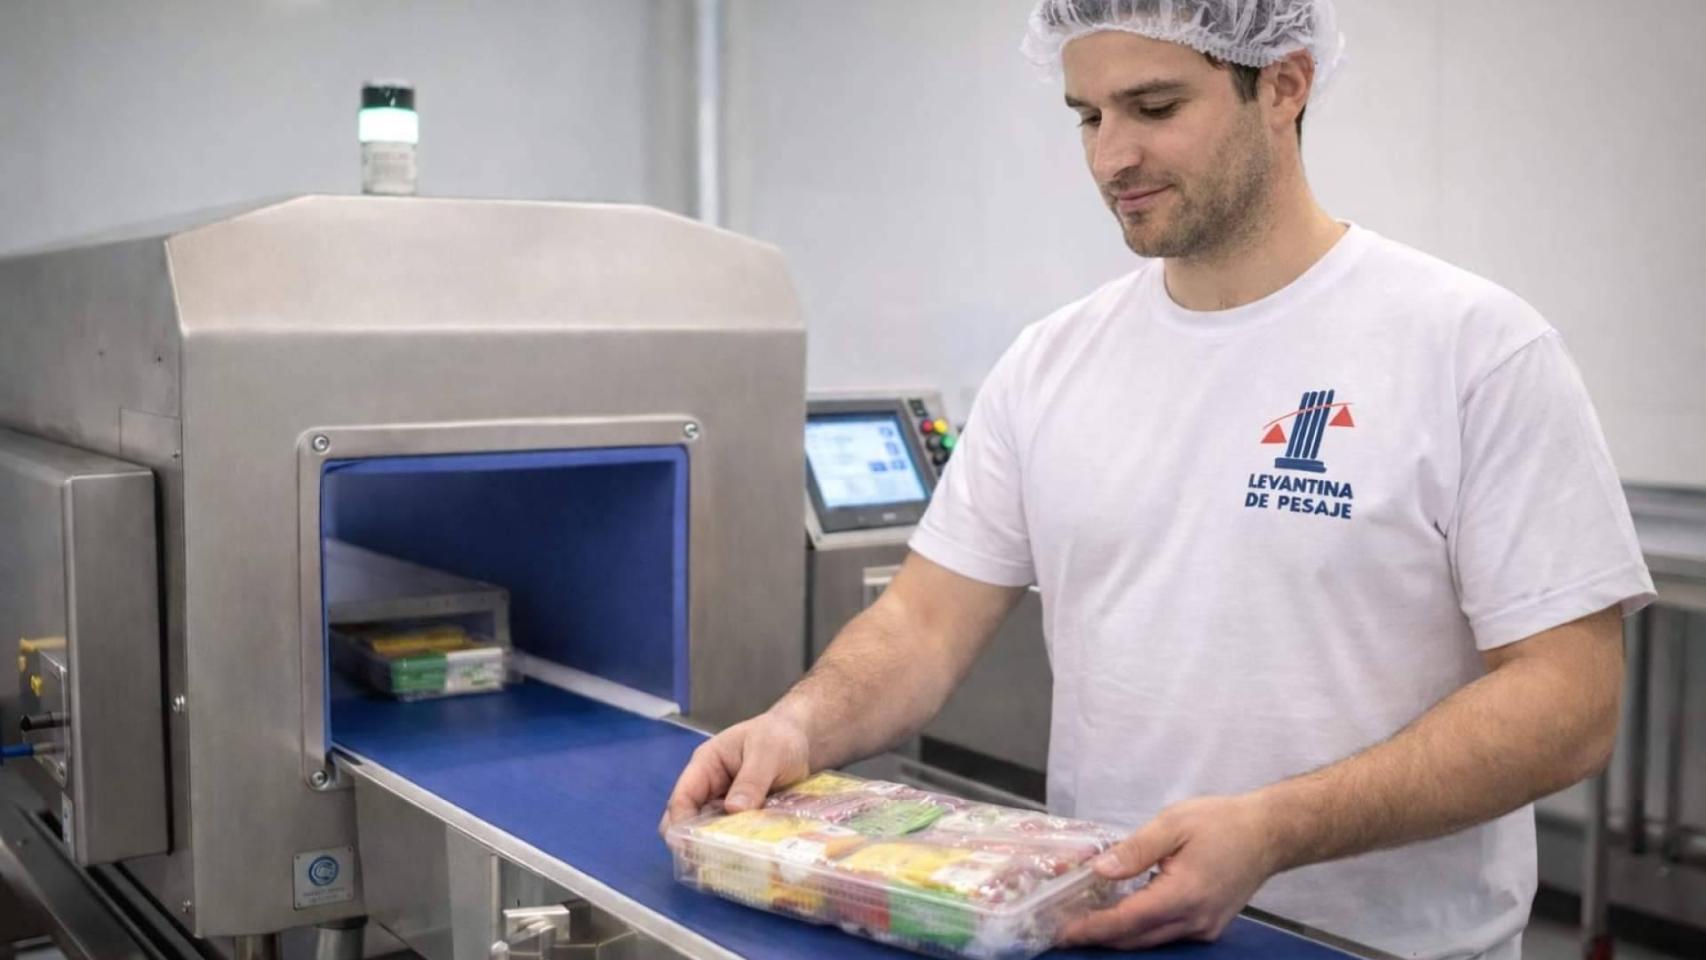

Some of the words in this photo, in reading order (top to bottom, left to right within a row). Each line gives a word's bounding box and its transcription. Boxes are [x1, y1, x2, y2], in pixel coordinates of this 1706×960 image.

[1248, 474, 1353, 499] LEVANTINA
[1245, 493, 1269, 508] DE
[1278, 496, 1352, 519] PESAJE
